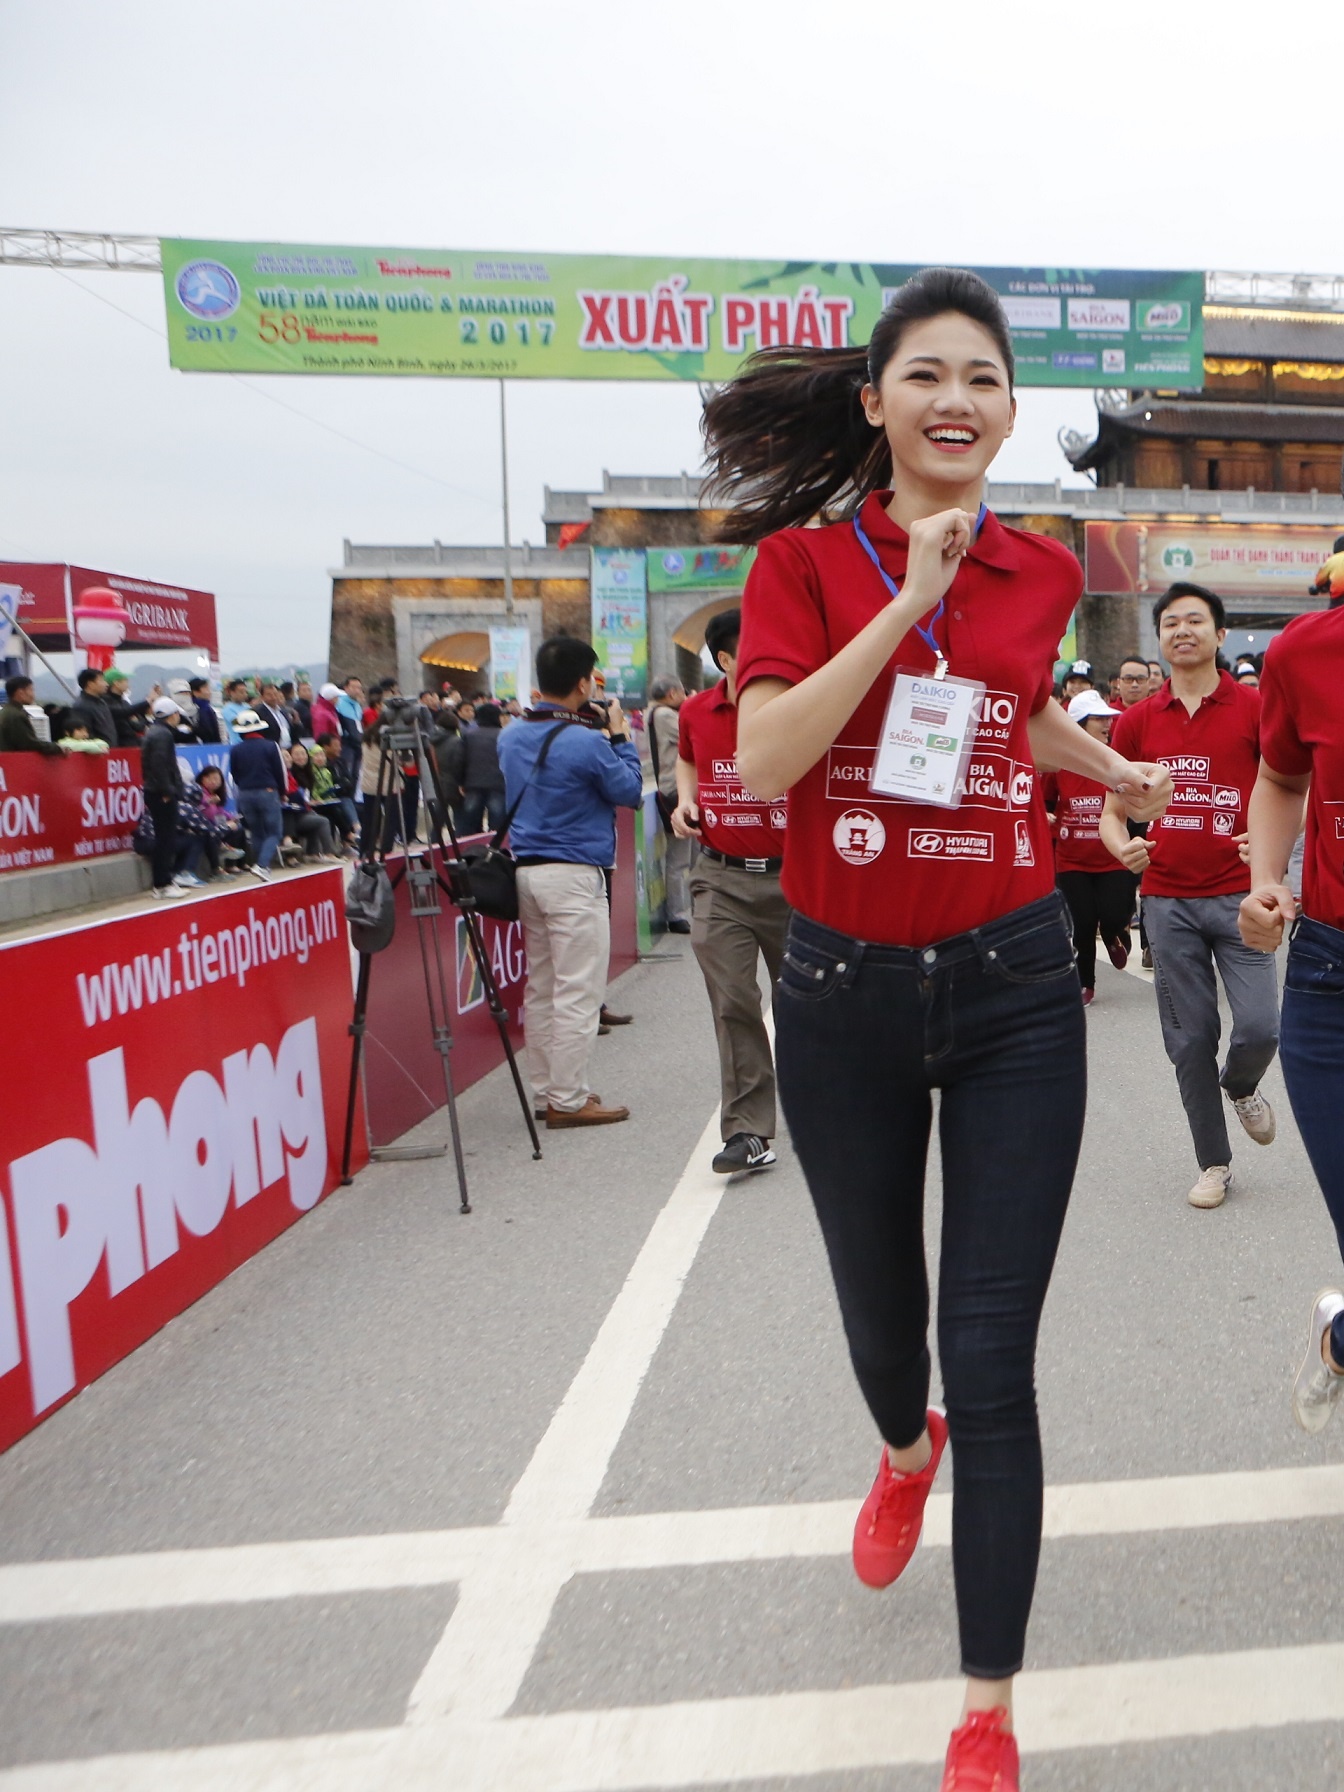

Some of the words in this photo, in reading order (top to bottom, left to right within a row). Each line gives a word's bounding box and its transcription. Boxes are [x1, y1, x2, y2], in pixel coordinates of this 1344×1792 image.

[459, 299, 555, 316] MARATHON
[580, 277, 710, 348] XUẤT
[724, 289, 851, 348] PHÁT
[185, 325, 238, 342] 2017
[258, 312, 301, 345] 58
[460, 319, 553, 346] 2017
[125, 600, 190, 632] AGRIBANK
[912, 682, 957, 700] DAIKIO
[969, 696, 1014, 724] KIO
[973, 727, 993, 737] CAO
[107, 759, 131, 783] BIA
[715, 762, 739, 773] DAI
[970, 764, 995, 776] BIA
[1160, 758, 1207, 771] DAIKIO
[81, 785, 146, 827] SAIGO
[1071, 797, 1101, 806] DAIKIO
[77, 898, 338, 1027] www.tienphong.vn
[0, 1016, 328, 1417] phong
